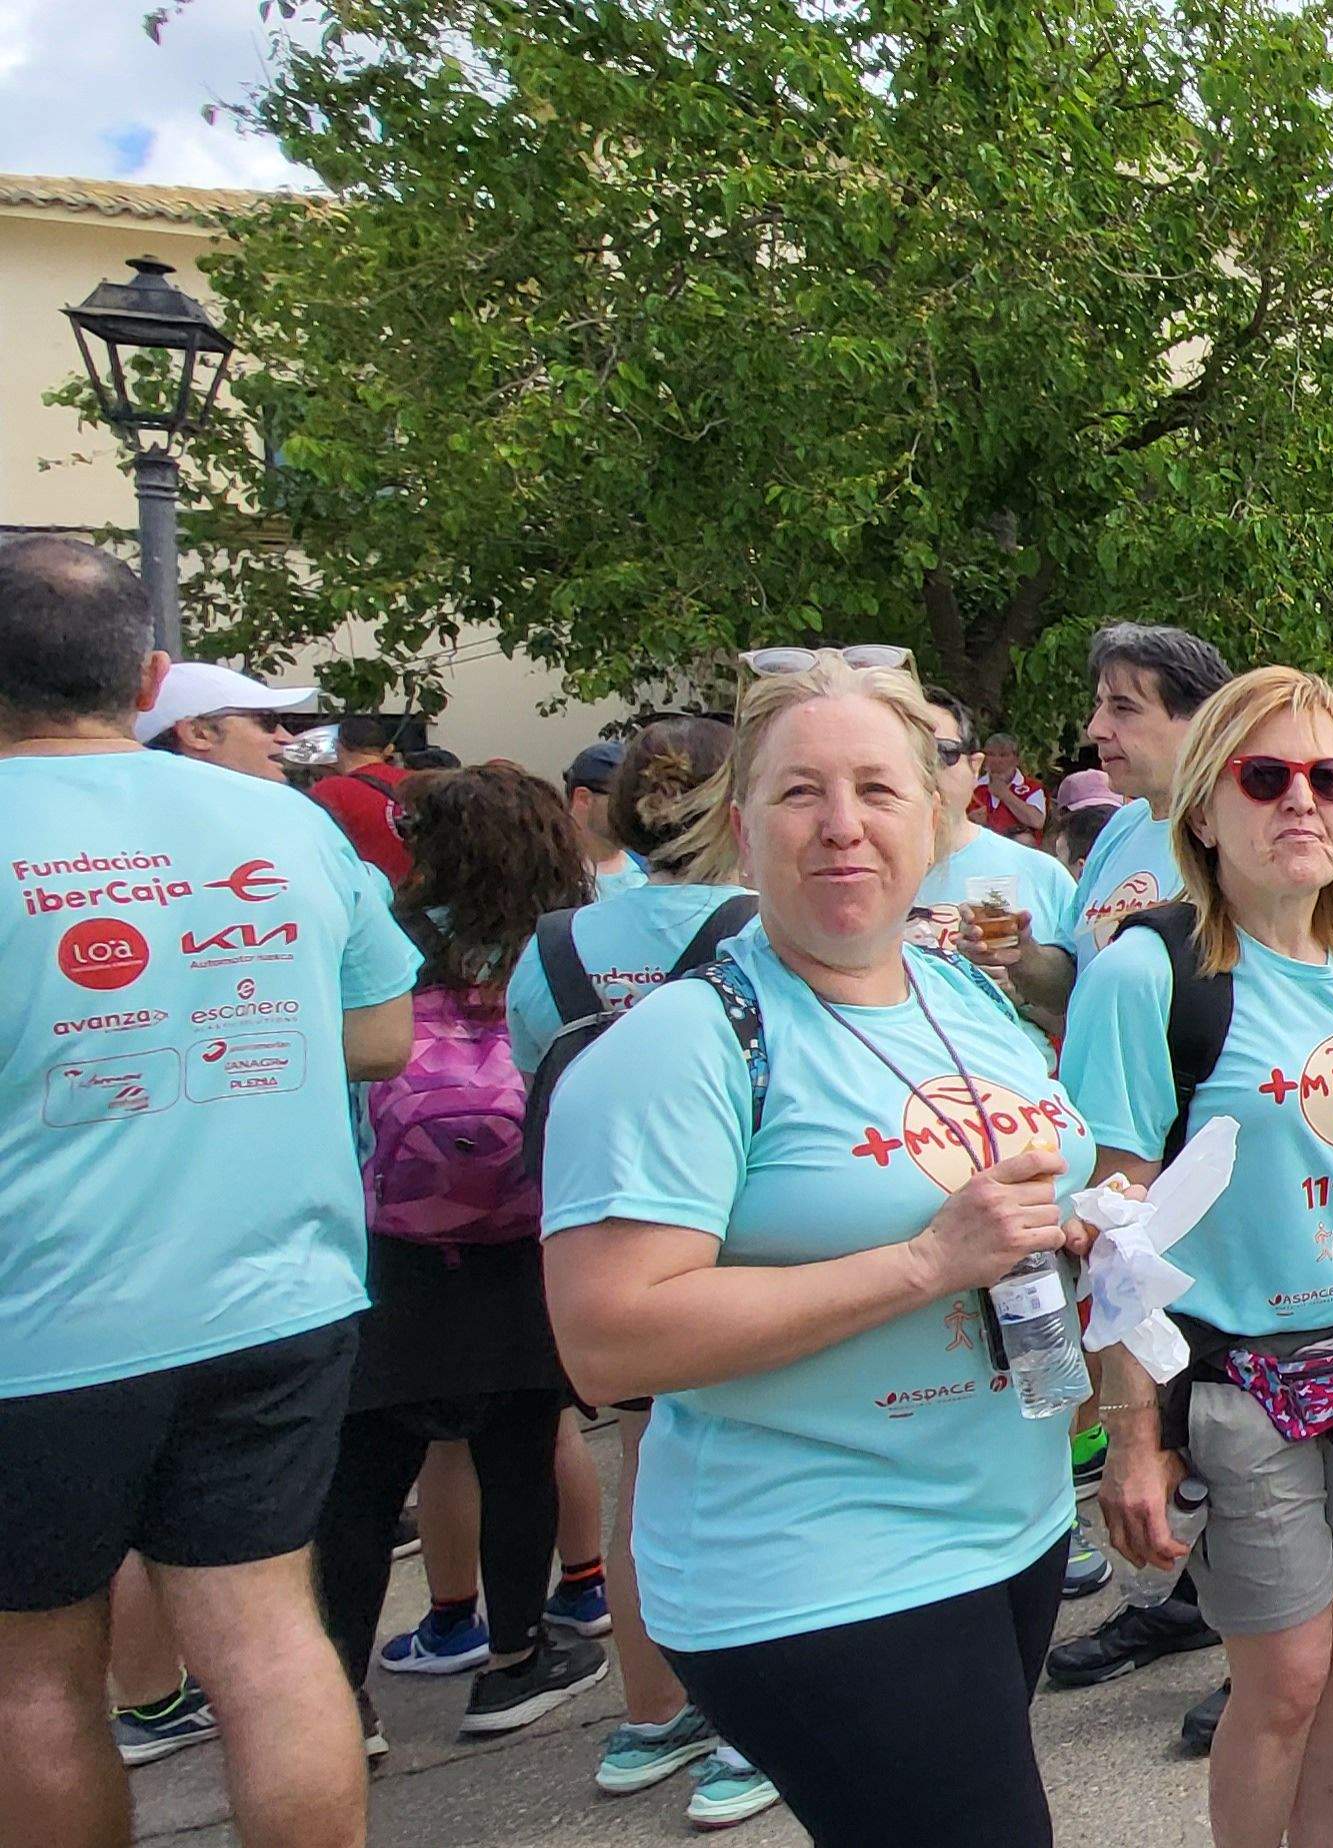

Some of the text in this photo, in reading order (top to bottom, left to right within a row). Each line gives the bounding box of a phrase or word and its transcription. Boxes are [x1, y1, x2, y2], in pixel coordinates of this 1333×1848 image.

[12, 851, 171, 880] Fundación
[23, 878, 193, 915] iberCaja
[181, 923, 298, 953] KIA
[53, 1010, 150, 1035] avanza
[191, 1001, 299, 1024] escanero
[852, 1093, 1086, 1168] +mayores
[900, 1381, 976, 1402] ASPACE
